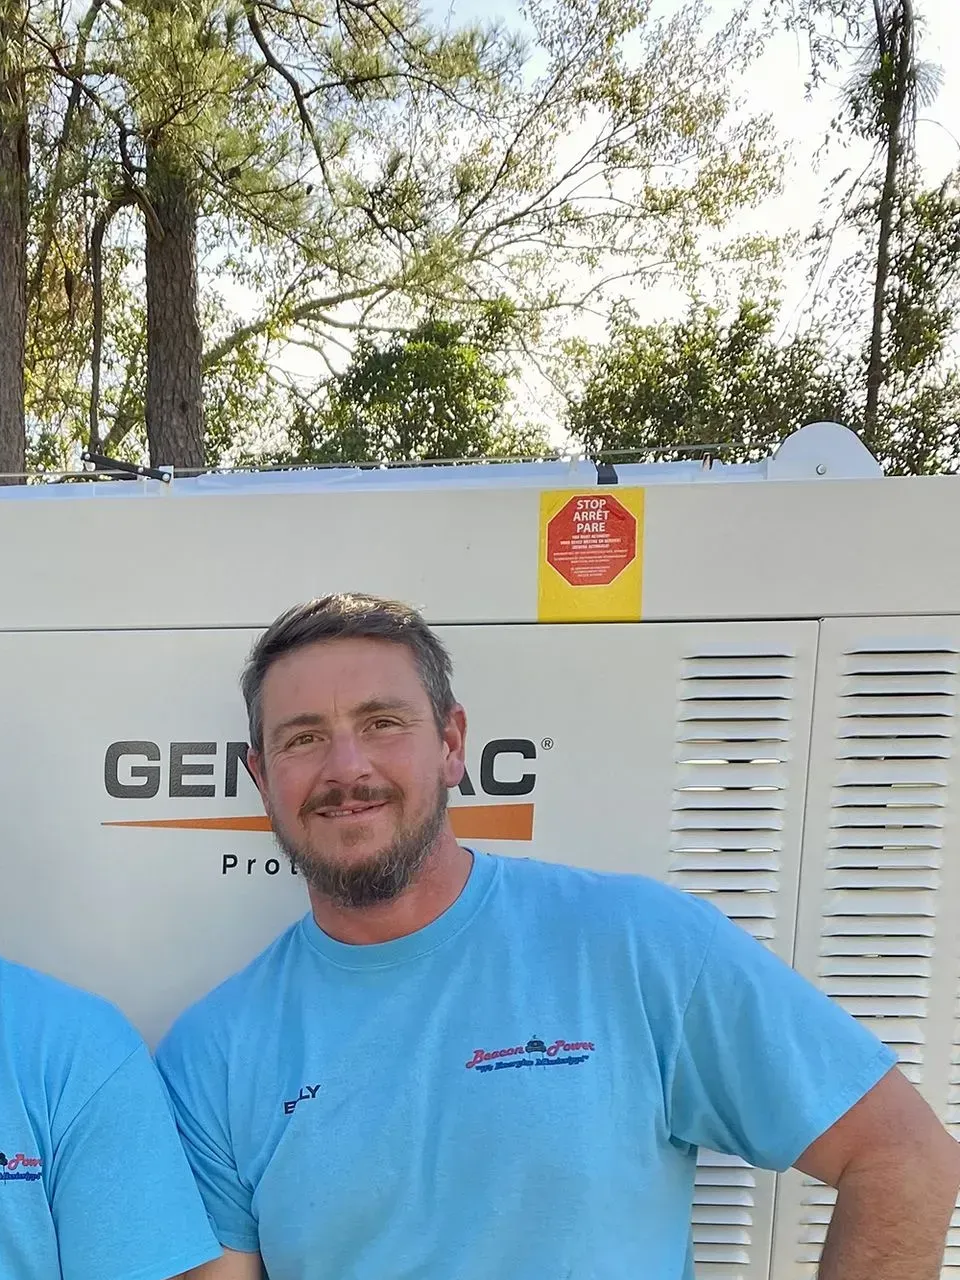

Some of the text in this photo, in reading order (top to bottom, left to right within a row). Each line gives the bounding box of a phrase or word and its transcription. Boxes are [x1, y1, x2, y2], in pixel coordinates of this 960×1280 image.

[576, 499, 606, 510] STOP
[573, 510, 610, 521] ARRÊT
[576, 522, 606, 533] PARE
[465, 1039, 595, 1069] Beacon Power
